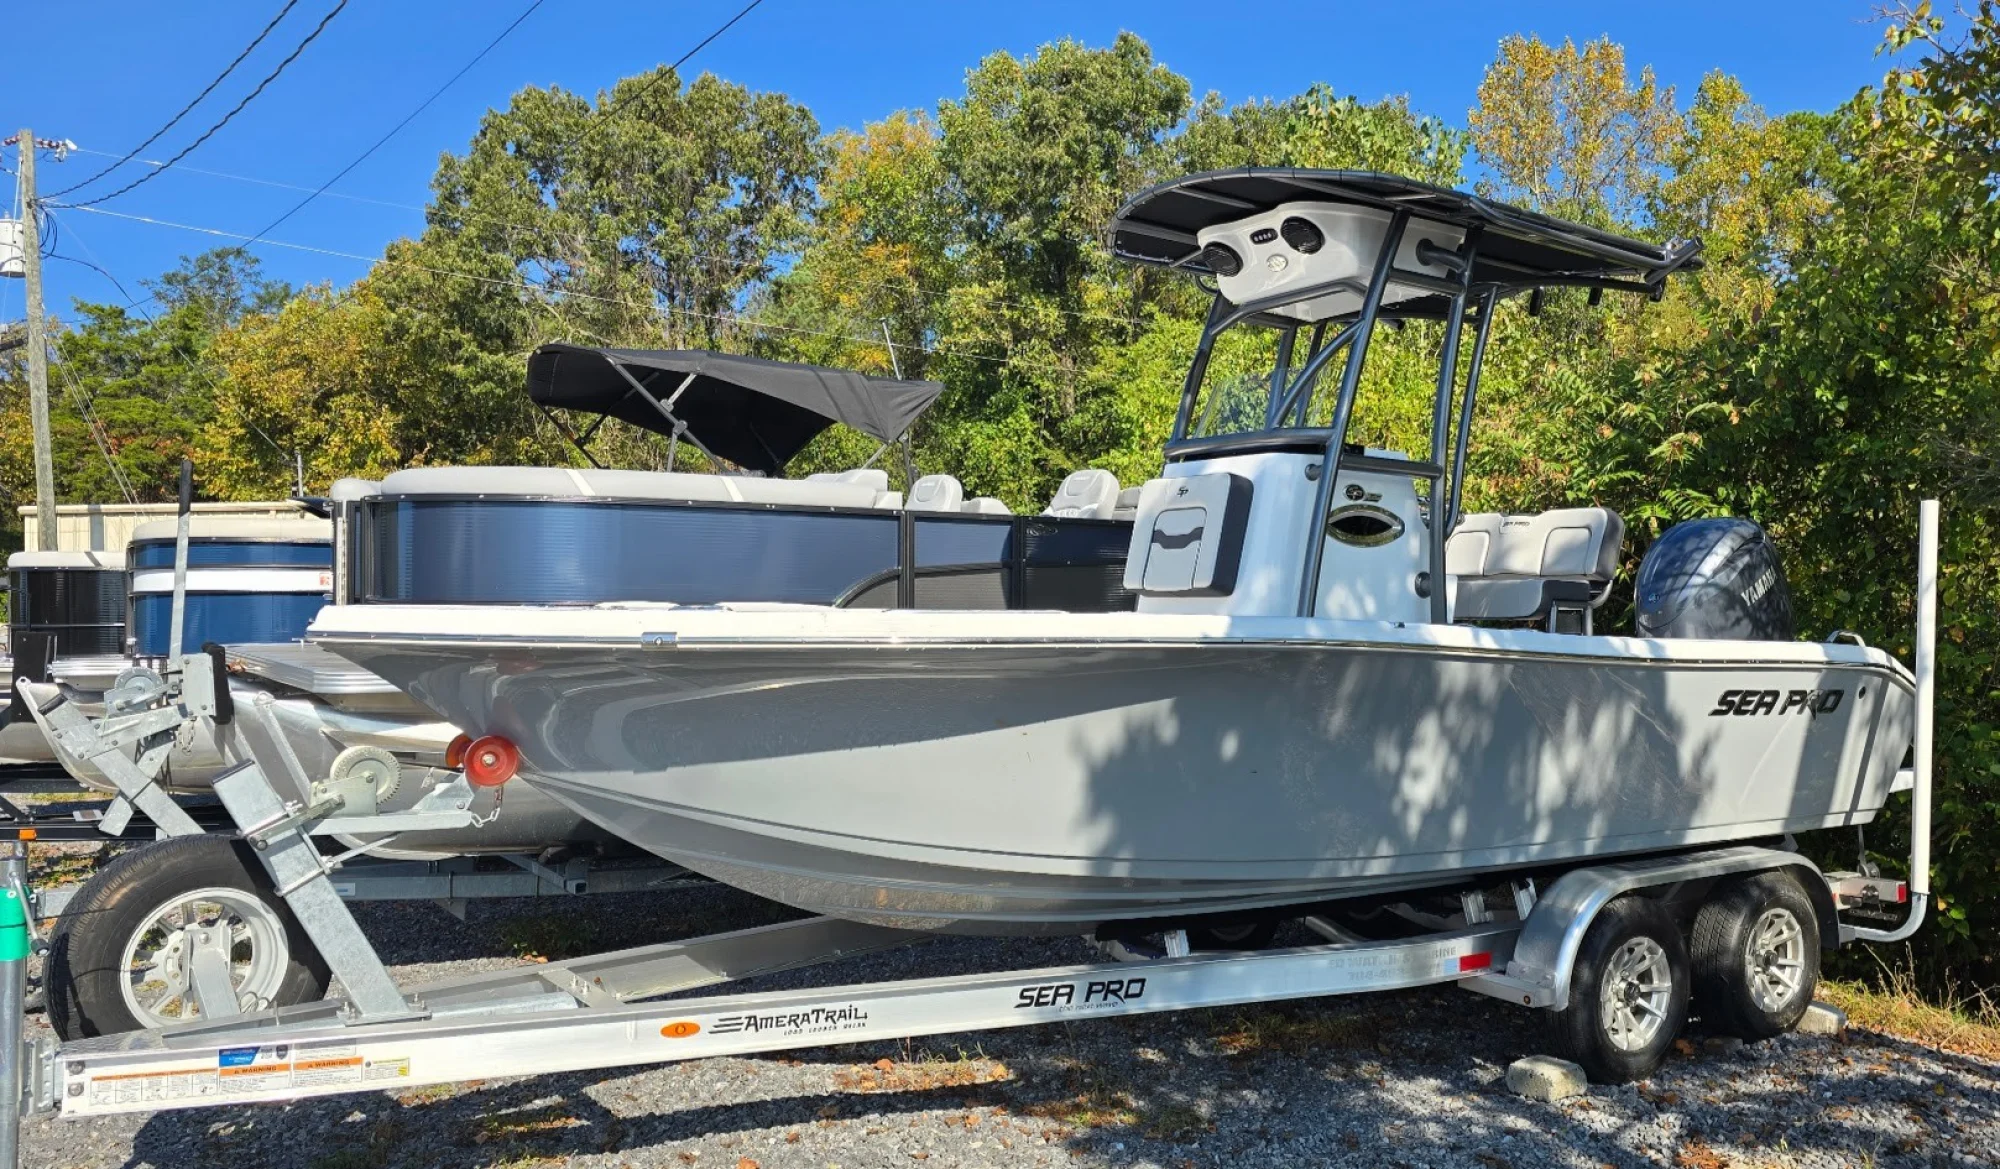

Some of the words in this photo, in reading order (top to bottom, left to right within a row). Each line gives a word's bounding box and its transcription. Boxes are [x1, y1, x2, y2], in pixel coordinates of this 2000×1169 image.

[1708, 689, 1780, 716] SEA
[1778, 689, 1844, 720] PRO
[1014, 984, 1075, 1008] SEA
[1084, 978, 1146, 1004] PRO
[241, 1065, 277, 1074] WARNING
